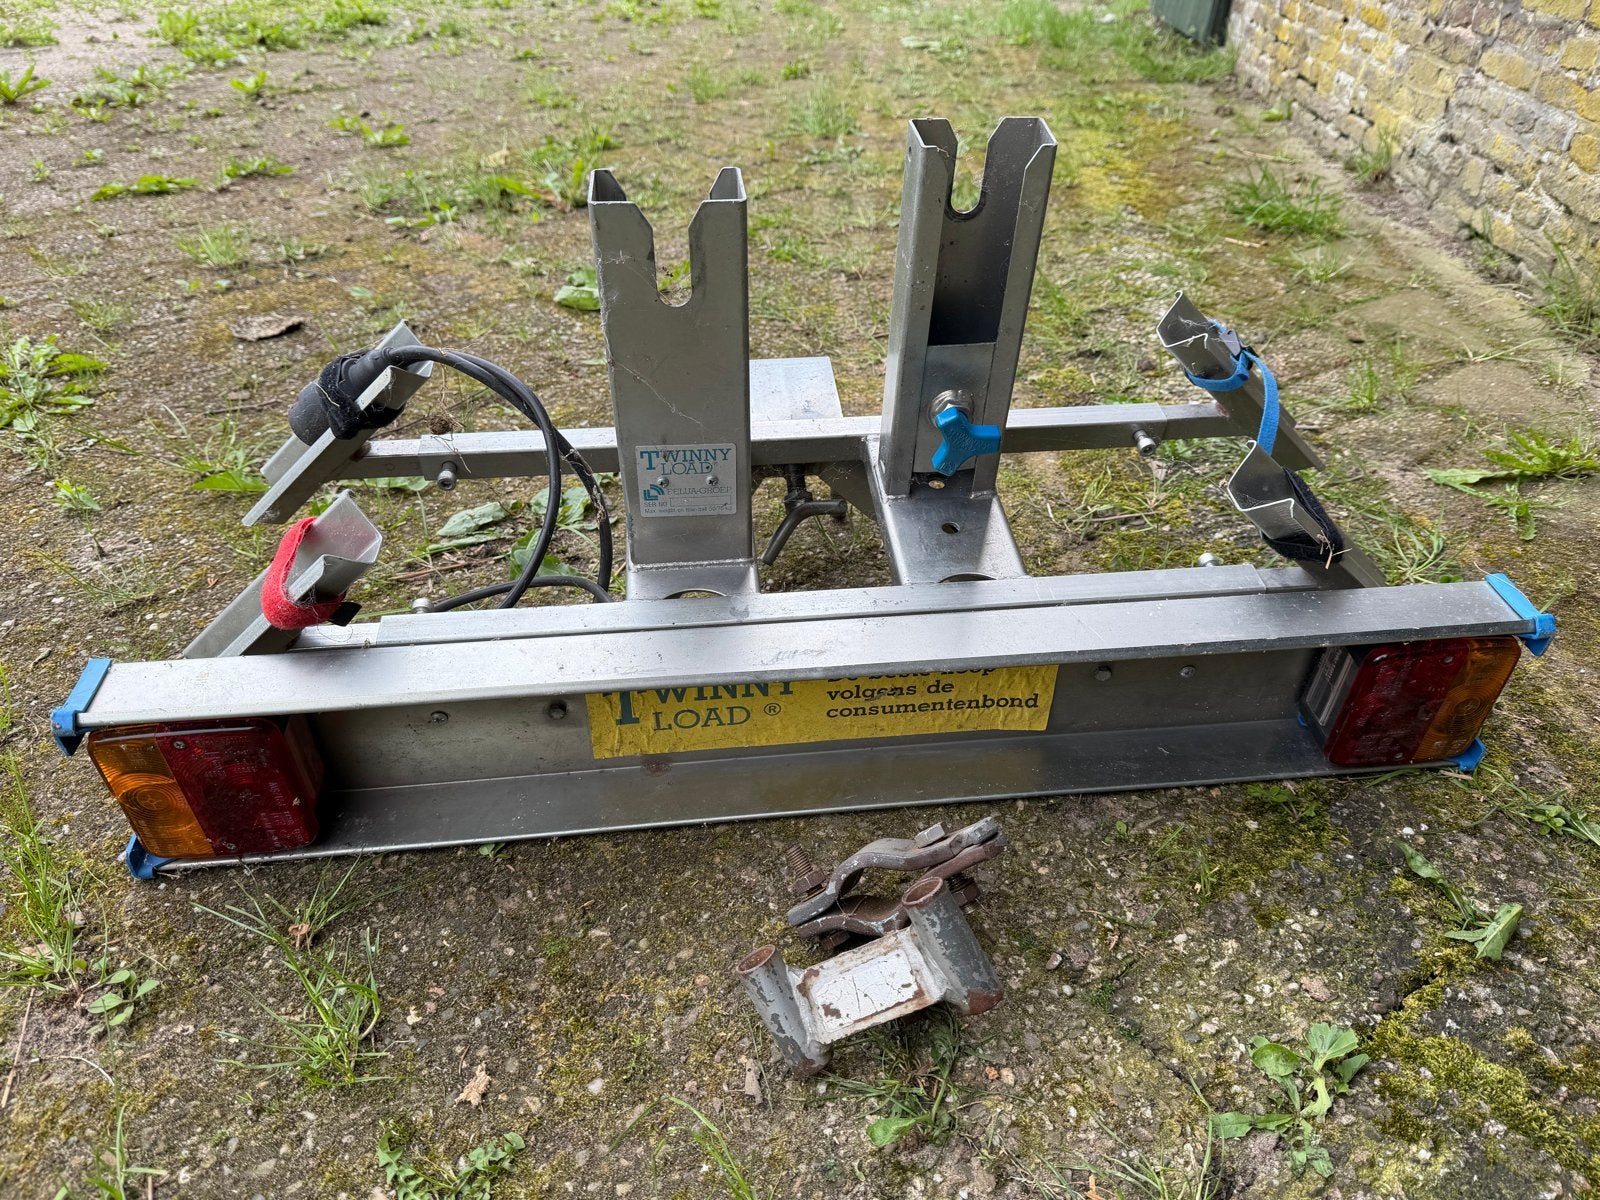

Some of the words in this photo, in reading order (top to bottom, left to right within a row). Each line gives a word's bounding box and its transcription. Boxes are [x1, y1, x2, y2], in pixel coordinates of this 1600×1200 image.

[640, 448, 732, 471] TWINNY
[661, 461, 713, 476] LOAD
[827, 684, 917, 700] volgens
[926, 679, 954, 694] de
[603, 682, 793, 725] TWINNY
[827, 693, 1039, 718] consumentenbond
[653, 705, 751, 731] LOAD
